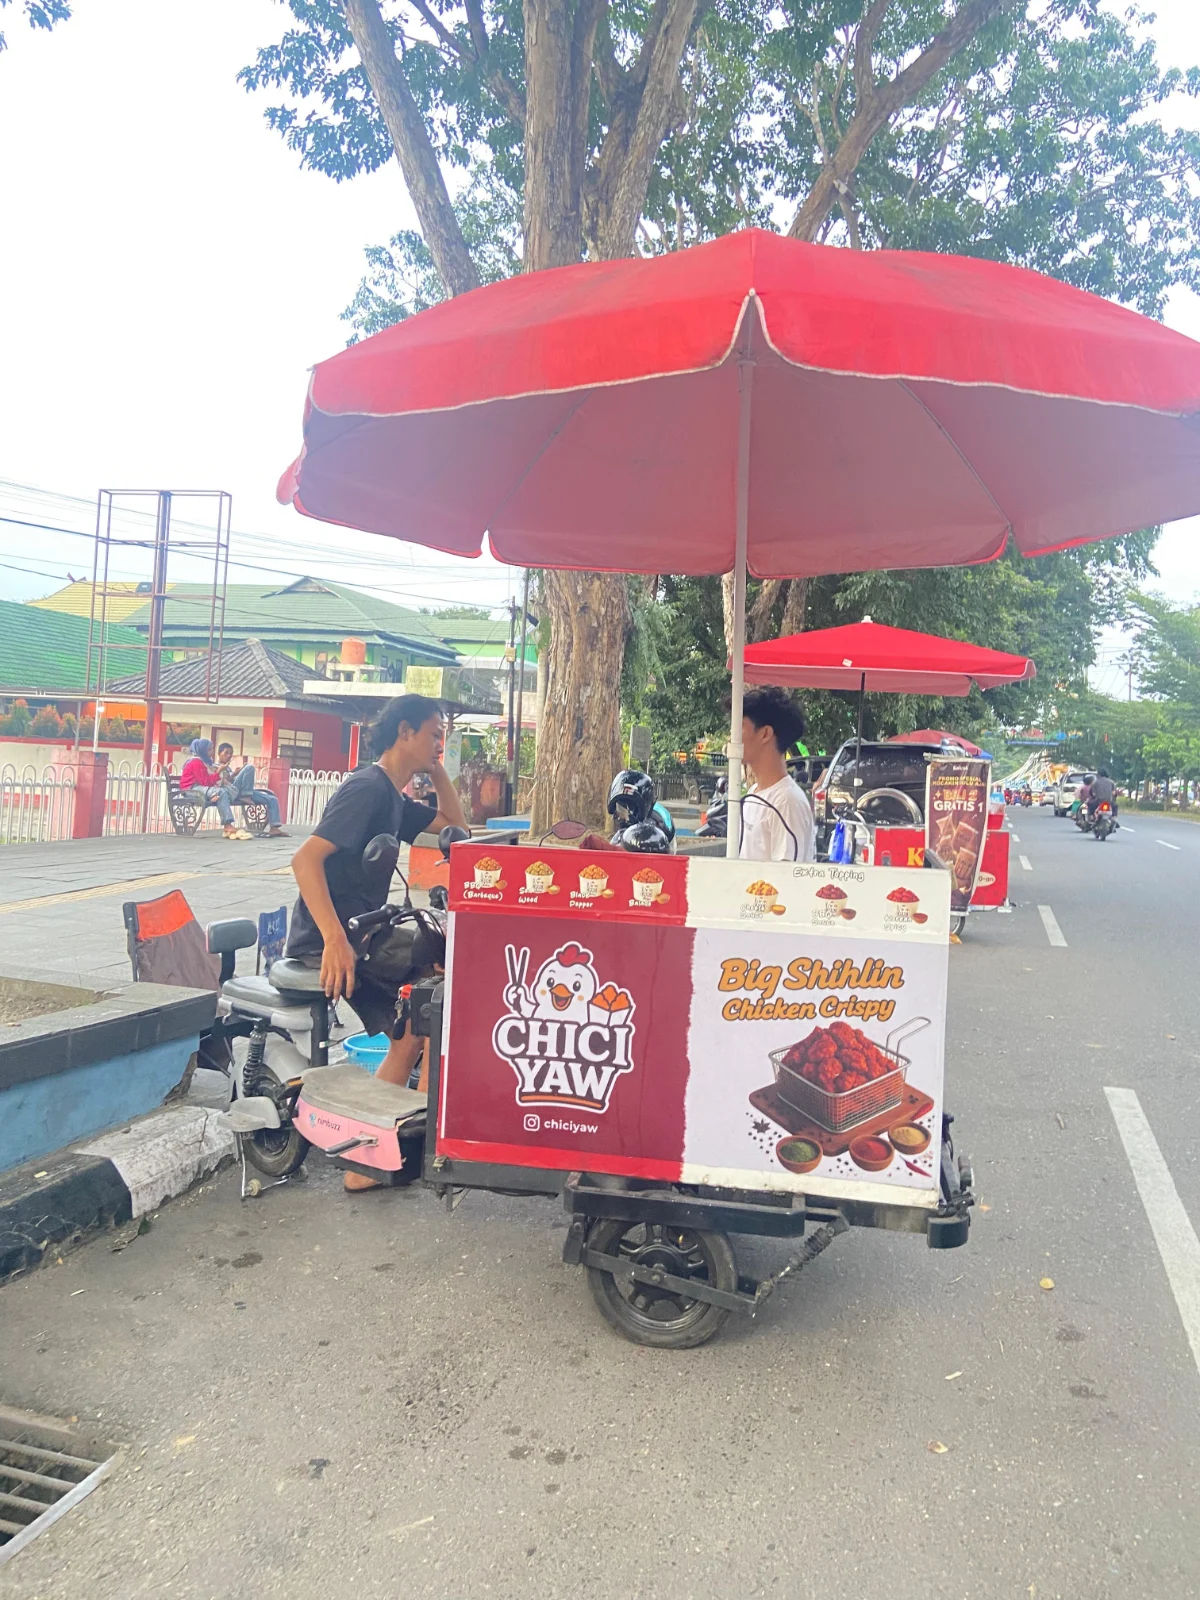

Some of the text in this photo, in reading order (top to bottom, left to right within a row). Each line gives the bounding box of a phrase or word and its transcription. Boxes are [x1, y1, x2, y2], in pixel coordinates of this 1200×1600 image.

[969, 789, 978, 801] 2
[933, 800, 984, 812] GRATIS 1
[793, 867, 865, 882] Extra Topping
[463, 890, 503, 901] (Barbeque)
[518, 895, 538, 903] Weed
[569, 900, 593, 909] Pepper
[718, 957, 905, 999] Big Shihlin
[722, 995, 896, 1022] Chicken Crispy
[496, 1018, 631, 1067] CHICI
[514, 1057, 616, 1101] YAW
[543, 1119, 599, 1134] chiciyaw
